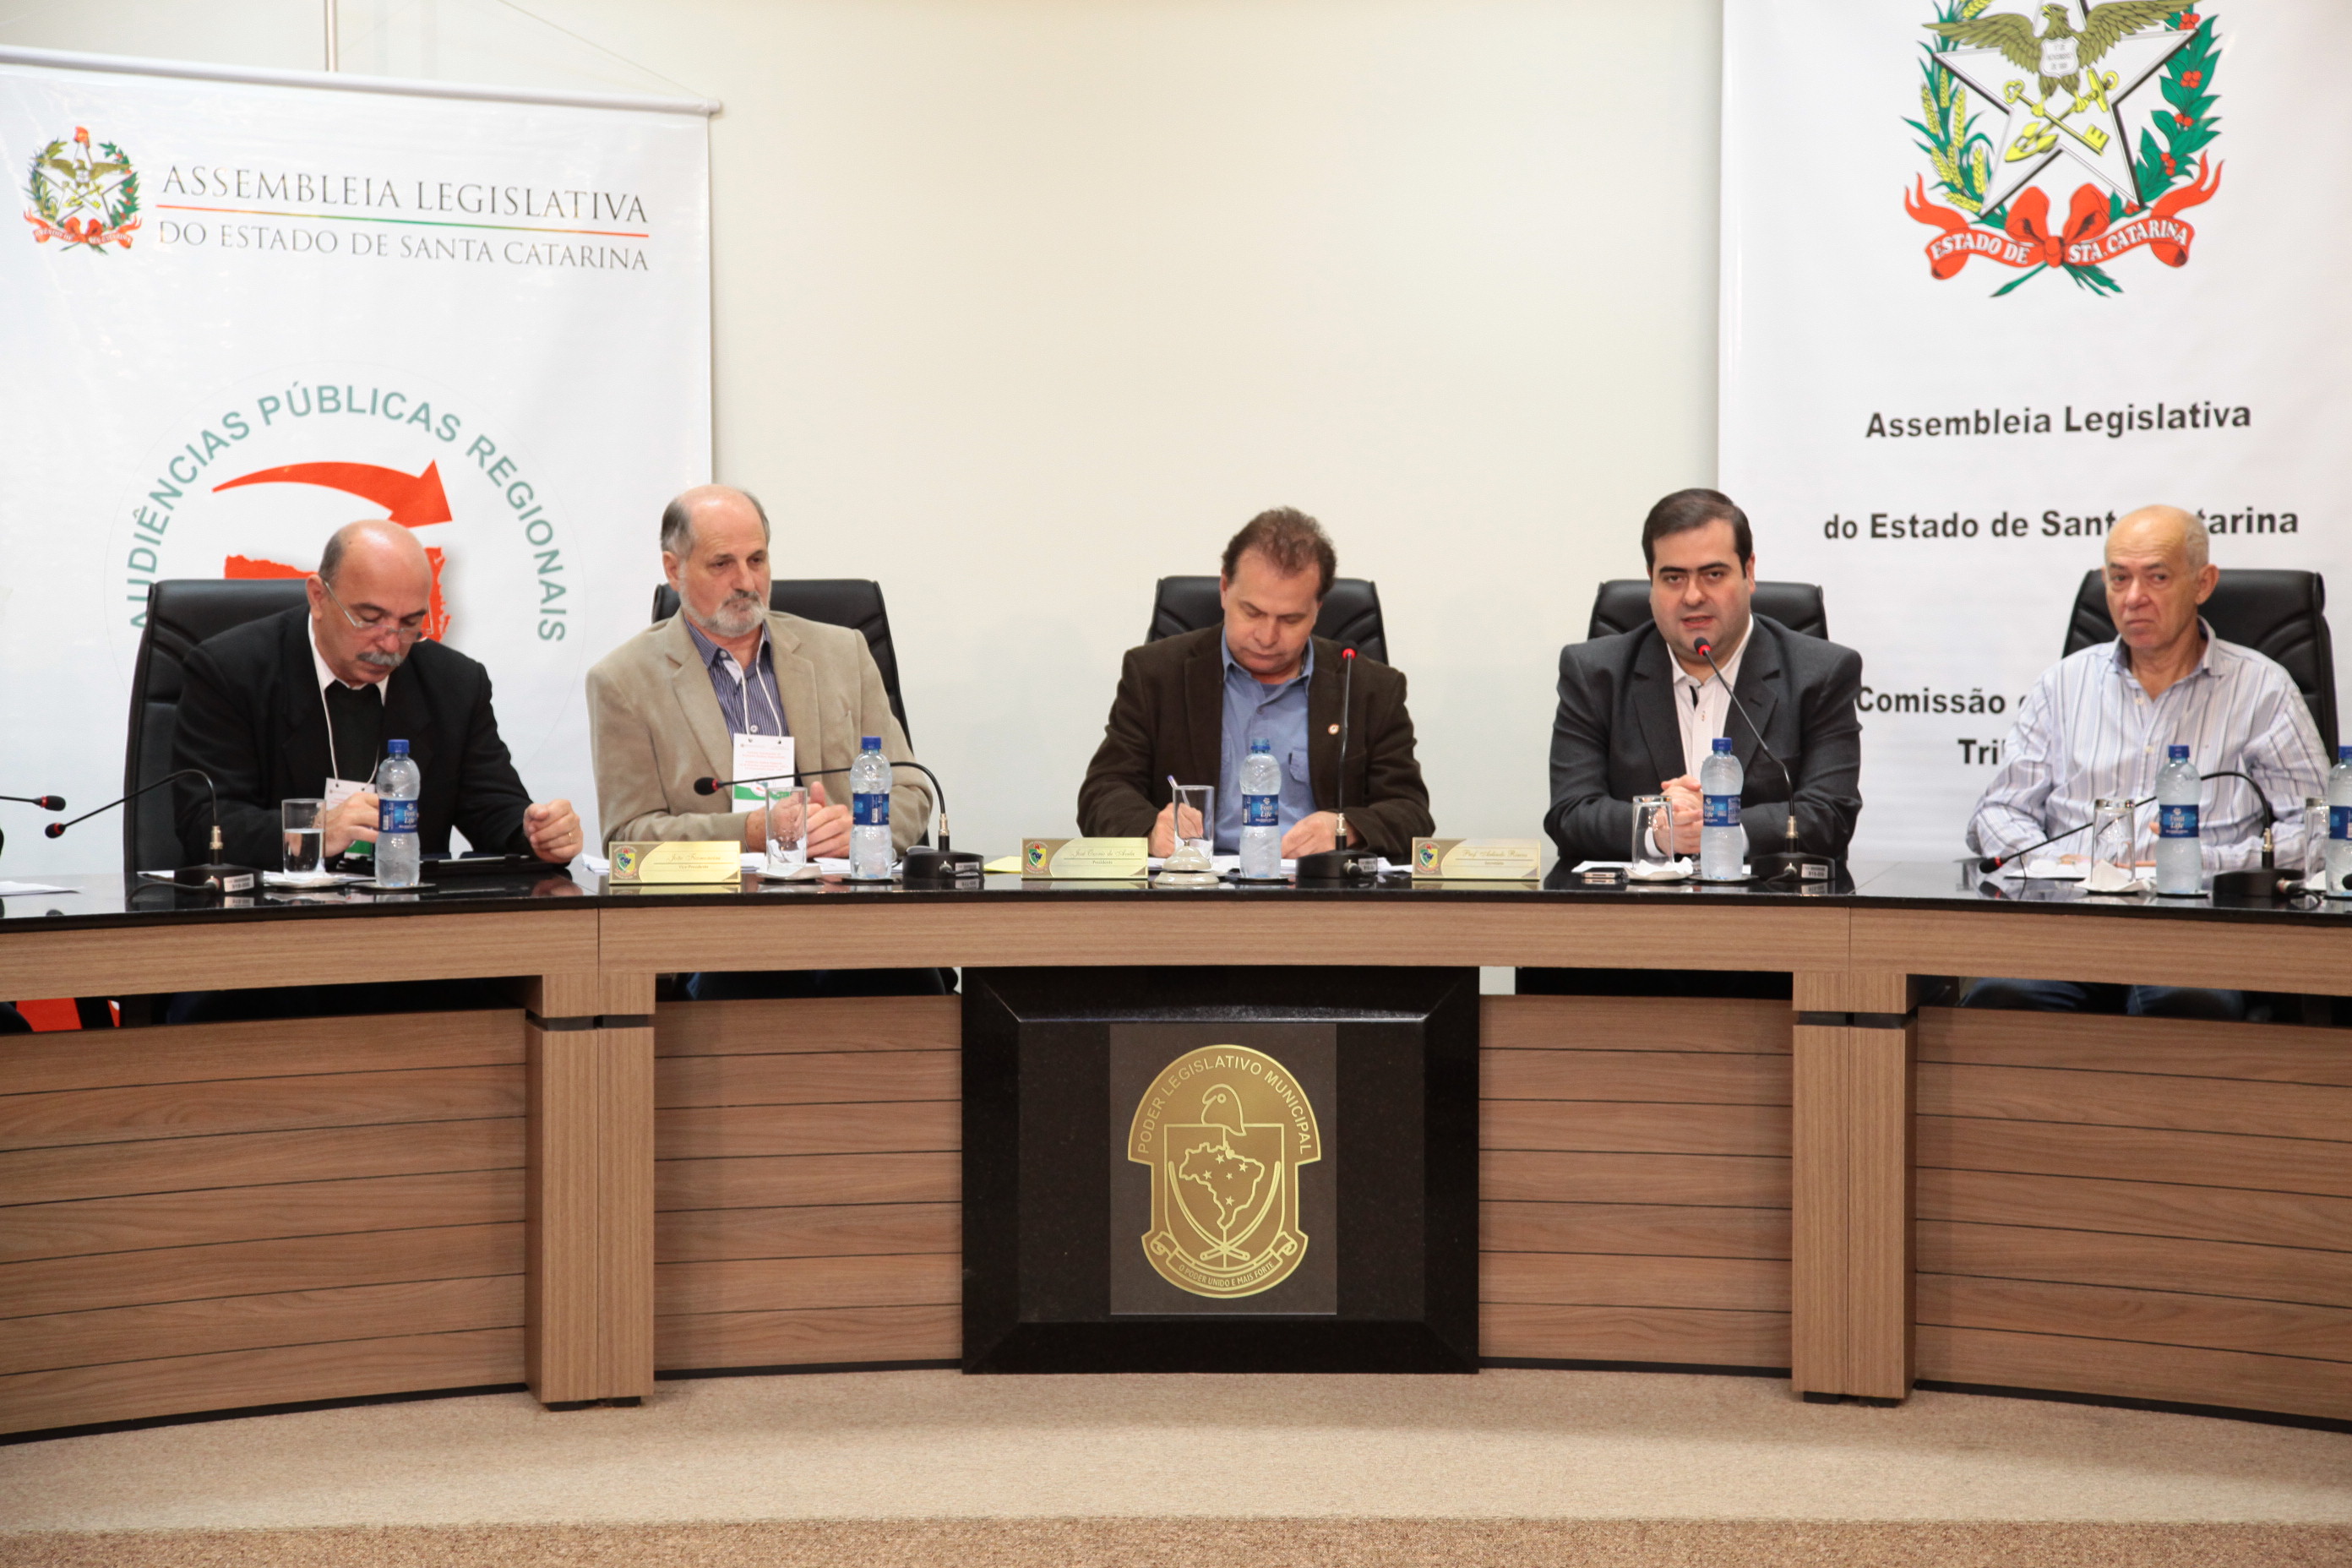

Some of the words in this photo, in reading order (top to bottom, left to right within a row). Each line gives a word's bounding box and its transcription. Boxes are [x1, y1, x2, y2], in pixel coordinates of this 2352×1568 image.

[163, 164, 400, 209] ASSEMBLEIA
[417, 182, 648, 223] LEGISLATIVA
[160, 220, 208, 246] DO
[221, 225, 338, 253] ESTADO
[351, 232, 388, 257] DE
[400, 237, 493, 264] SANTA
[504, 242, 650, 271] CATARINA
[1931, 233, 2002, 260] ESTADO
[2003, 242, 2029, 264] DE
[2070, 242, 2107, 263] STA.
[2107, 218, 2188, 253] CATARINA
[1865, 407, 2051, 438] Assembleia
[2065, 401, 2251, 439] Legislativa
[257, 381, 461, 443] PÚBLICAS
[466, 434, 567, 643] REGIONAIS
[1824, 514, 1858, 540] do
[1870, 512, 1979, 539] Estado
[1991, 511, 2028, 537] de
[2041, 510, 2115, 537] Sant
[1856, 685, 2006, 715] Comissão
[1137, 1096, 1166, 1154] PODER
[1161, 1054, 1262, 1097] LEGISLATIVO
[1264, 1070, 1312, 1155] MUNICIPAL
[1184, 1267, 1206, 1283] PODER
[1207, 1277, 1230, 1288] UNIDO
[1237, 1273, 1254, 1285] MAIS
[1254, 1260, 1275, 1279] FORTE
